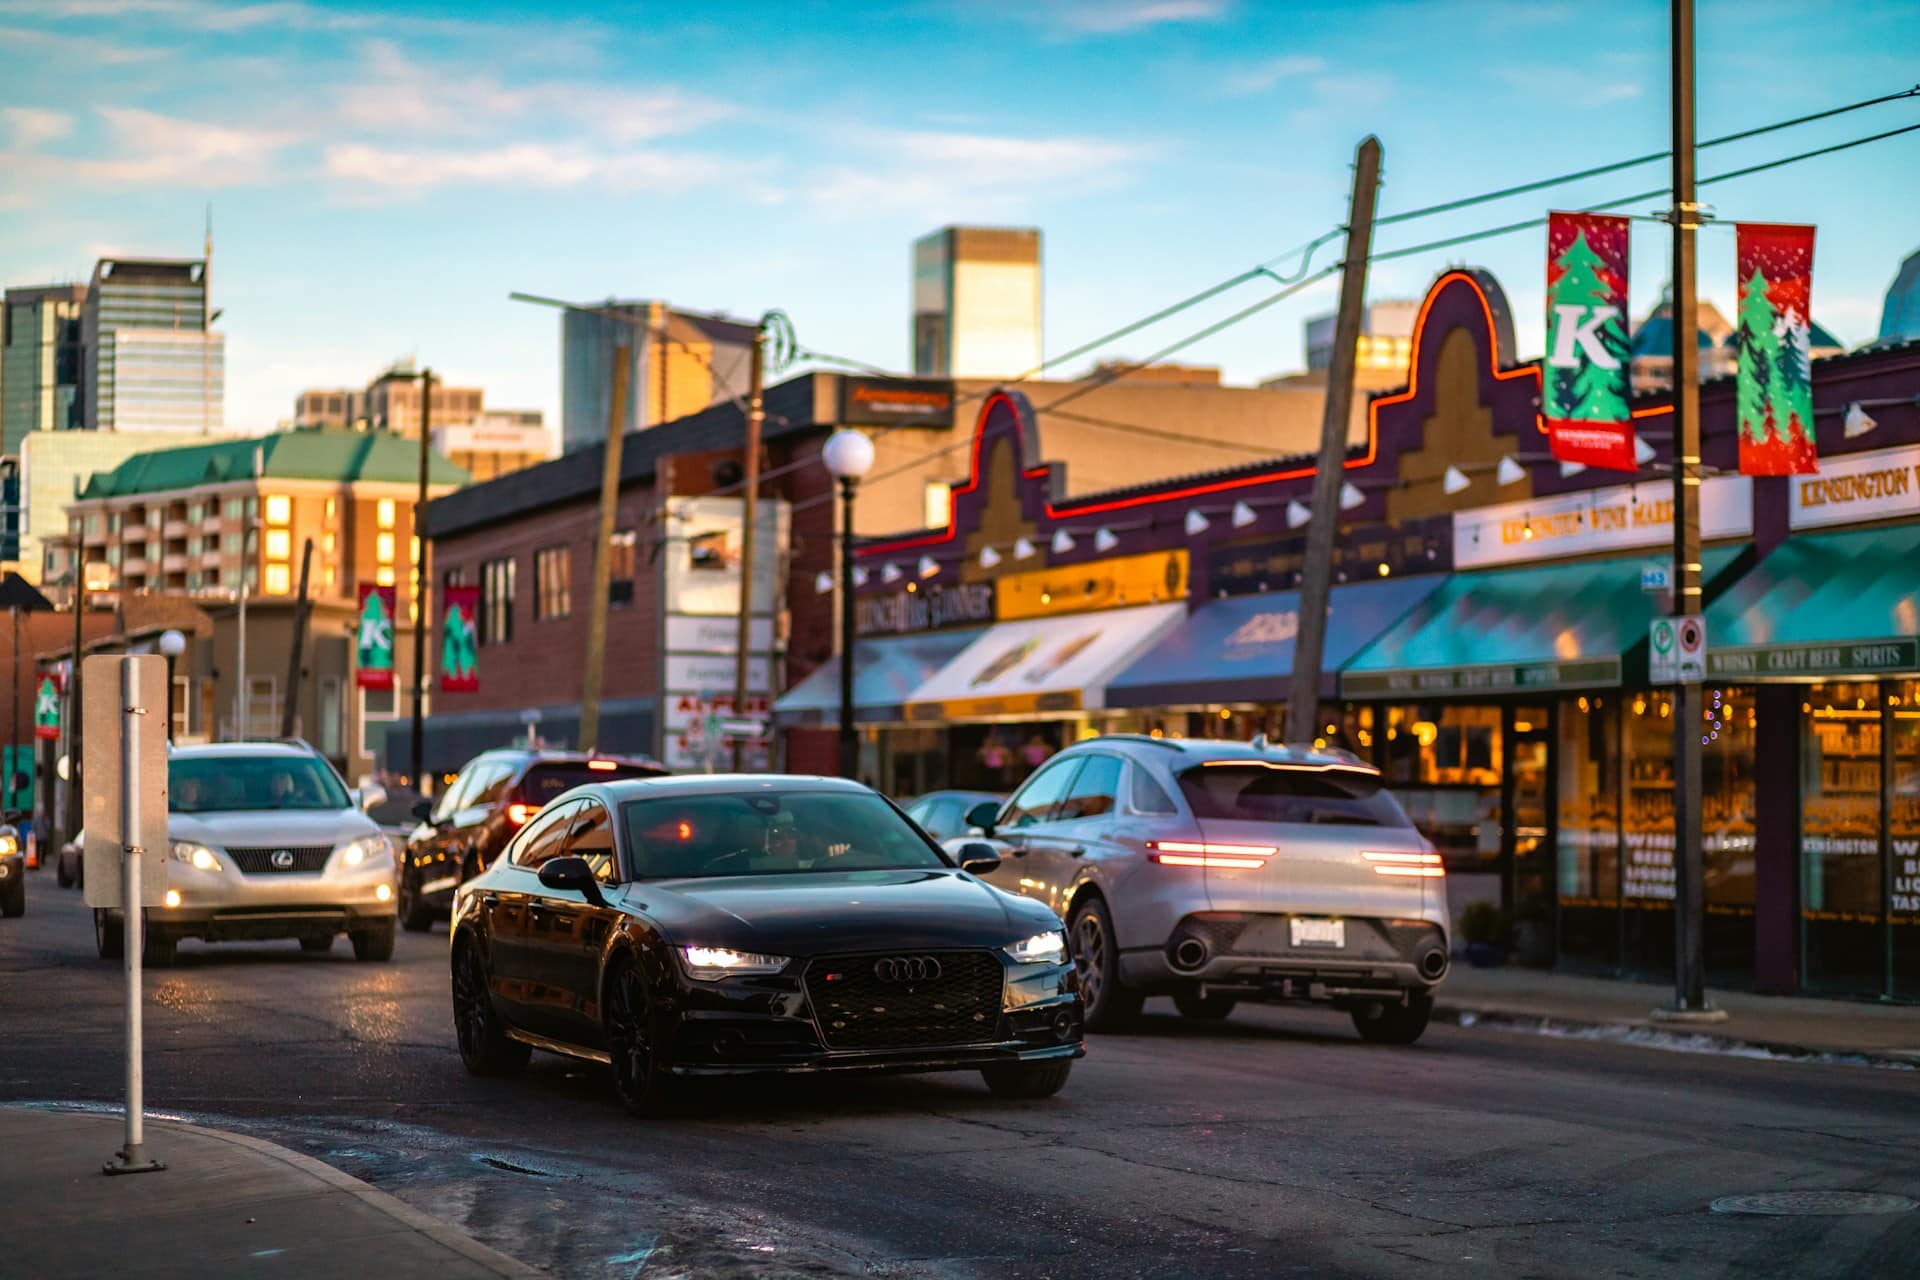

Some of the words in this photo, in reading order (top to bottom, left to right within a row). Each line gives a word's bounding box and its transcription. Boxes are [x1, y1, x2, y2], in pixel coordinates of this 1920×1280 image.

[1549, 304, 1621, 369] K
[1800, 467, 1908, 508] KENSINGTON
[360, 619, 392, 650] K
[1768, 650, 1806, 670] CRAFT
[1809, 648, 1841, 668] BEER
[1852, 645, 1901, 666] SPIRITS
[39, 694, 58, 714] K
[1803, 838, 1878, 854] KENSINGTON
